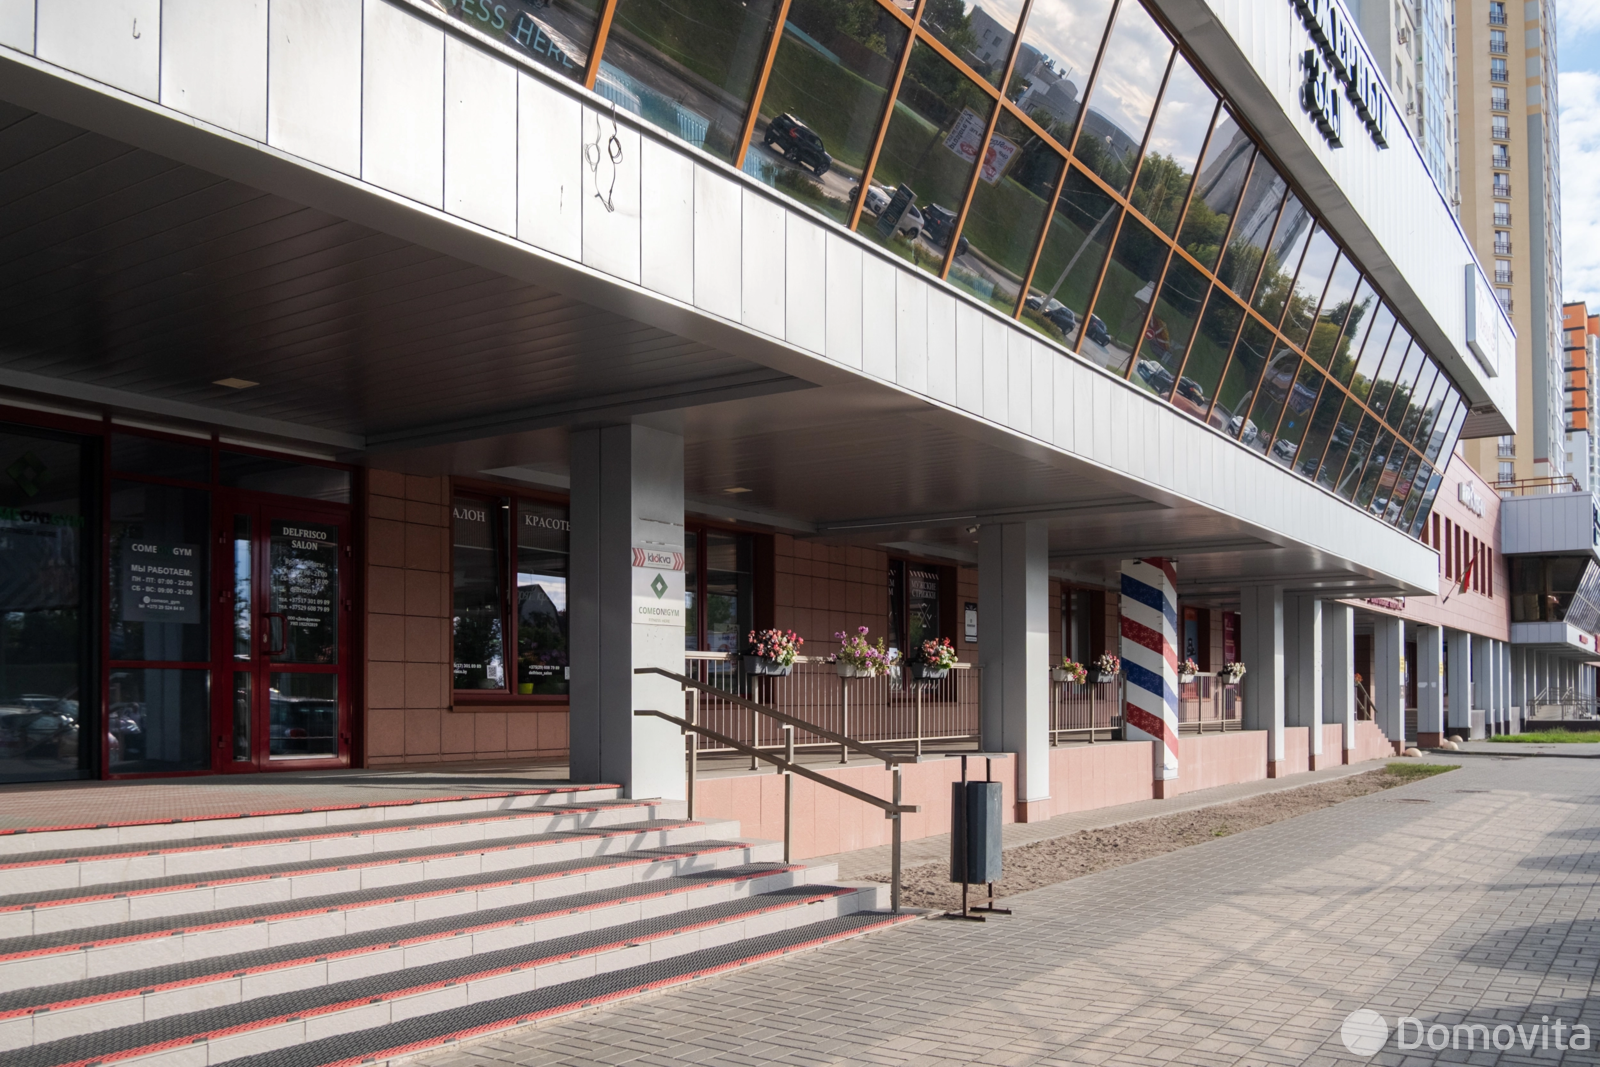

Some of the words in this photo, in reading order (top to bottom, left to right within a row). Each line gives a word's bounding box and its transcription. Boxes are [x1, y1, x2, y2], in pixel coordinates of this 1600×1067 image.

[452, 0, 507, 30] ESS
[1304, 49, 1343, 148] ЗАЛ
[453, 507, 486, 522] АЛОН
[282, 527, 327, 540] DELFRISCO
[291, 540, 318, 551] SALON
[131, 564, 146, 572] МЫ
[147, 566, 193, 577] РАБОТАЕМ:
[177, 579, 194, 587] 22:00
[911, 580, 937, 591] МУЖСКИЕ
[911, 588, 937, 599] СТРИЖКИ
